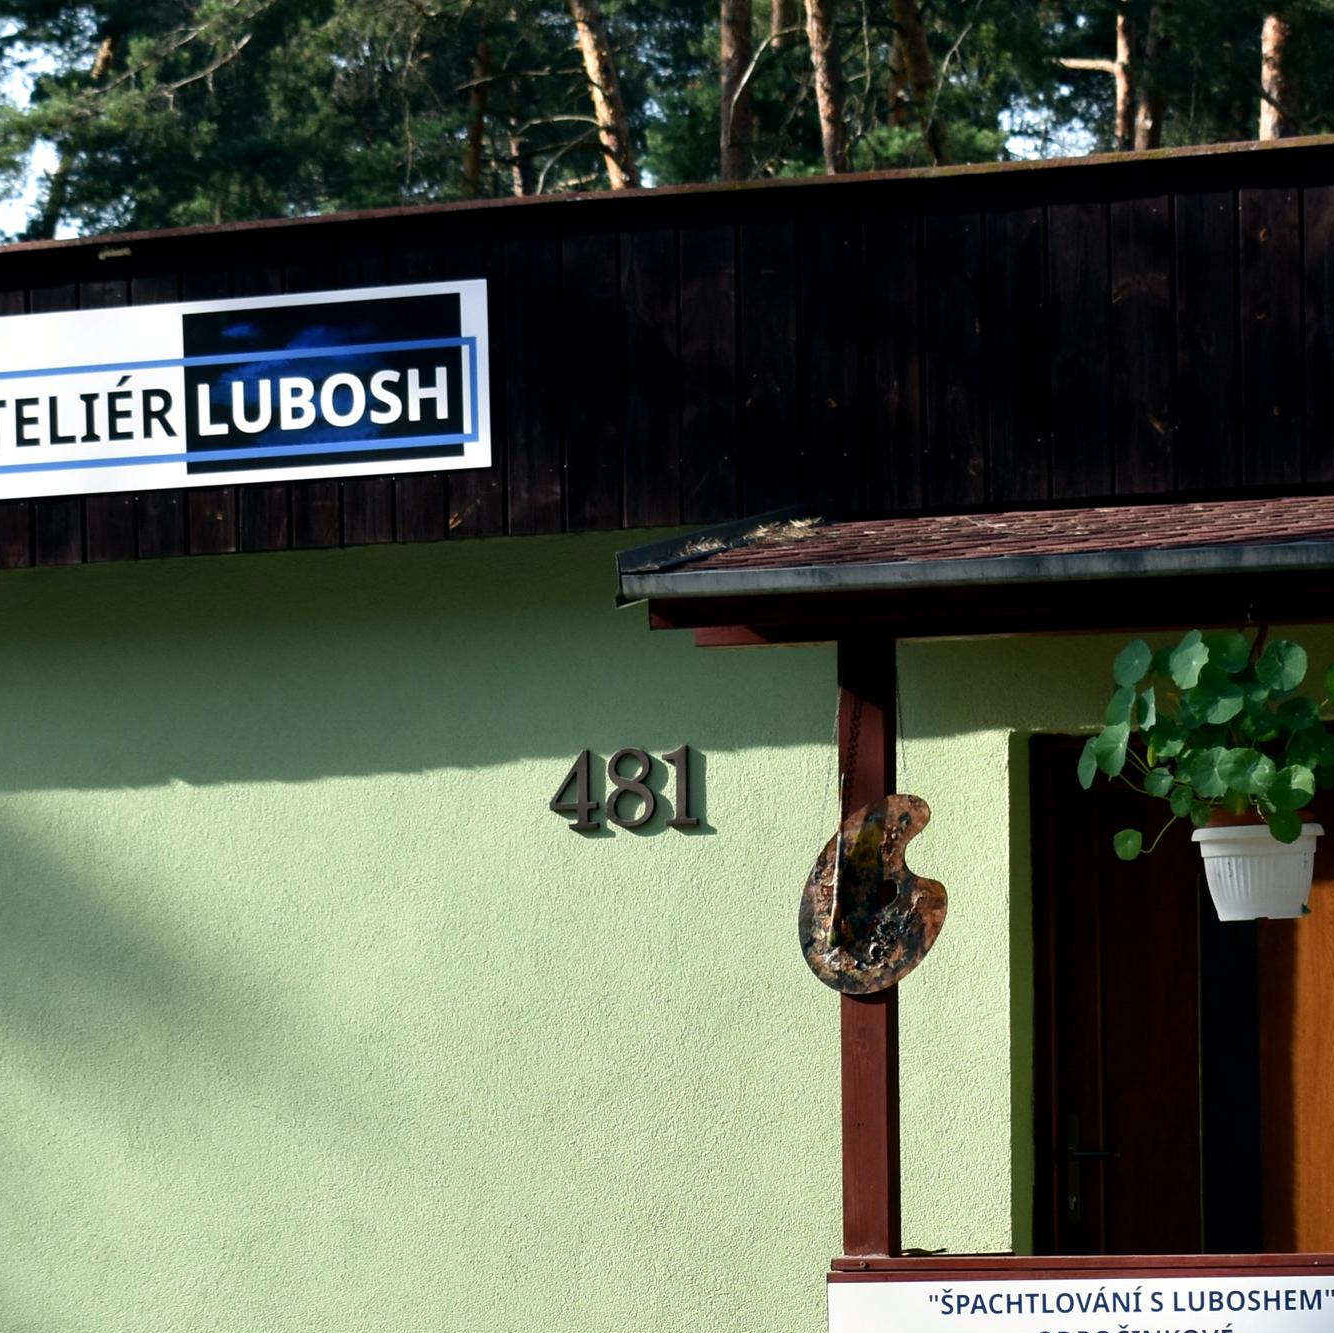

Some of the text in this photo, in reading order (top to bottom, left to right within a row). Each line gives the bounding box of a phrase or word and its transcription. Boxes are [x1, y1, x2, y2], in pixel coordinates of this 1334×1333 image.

[197, 366, 450, 436] LUBOSH
[550, 744, 700, 831] 481
[929, 1286, 1143, 1315] "ŠPACHTLOVÁNÍ
[1150, 1291, 1163, 1312] S
